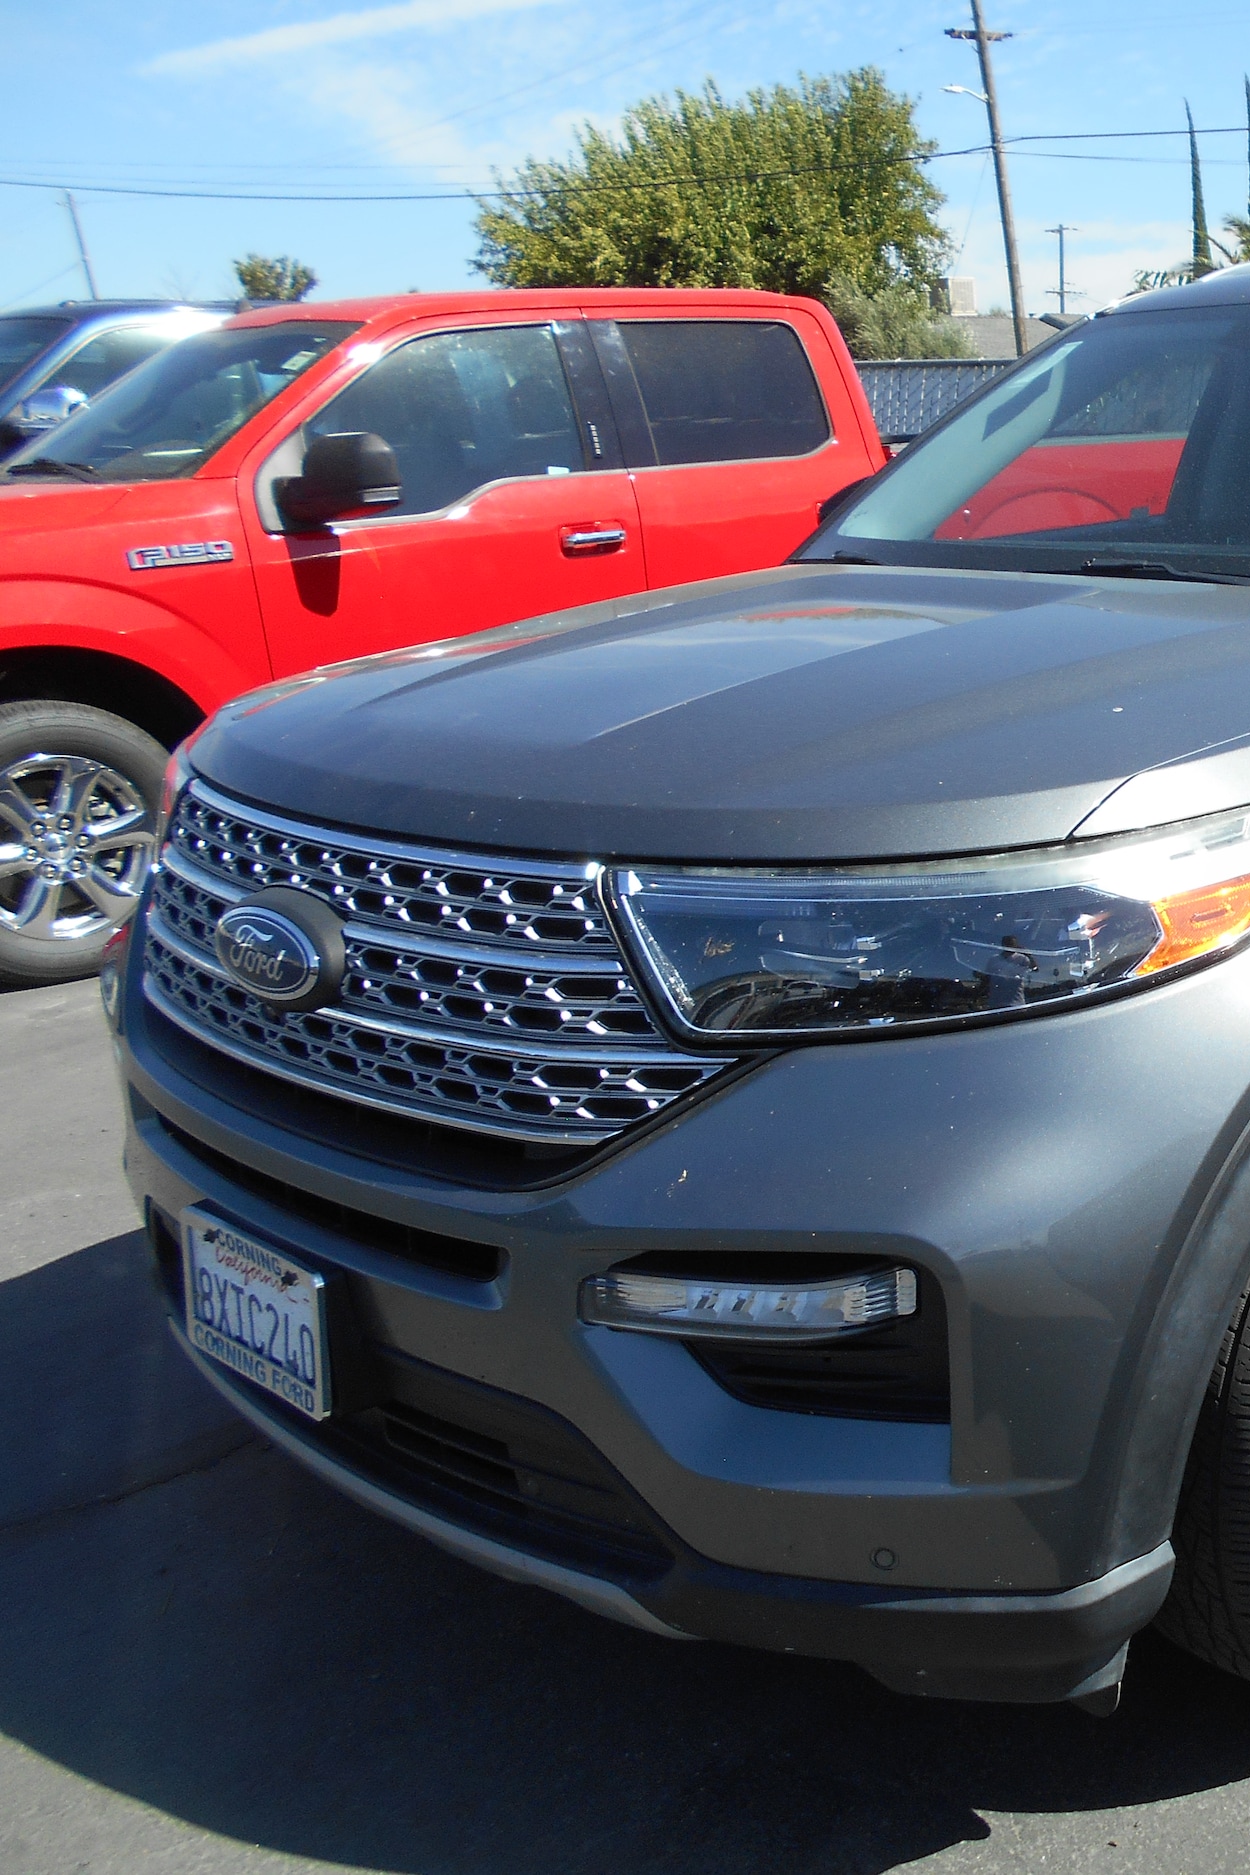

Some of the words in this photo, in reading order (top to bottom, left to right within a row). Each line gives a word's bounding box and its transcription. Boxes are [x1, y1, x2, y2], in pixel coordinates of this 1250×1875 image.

[229, 924, 286, 981] Ford
[216, 1228, 282, 1276] CORNING
[194, 1323, 267, 1383] CORNING
[272, 1370, 315, 1413] FORD
